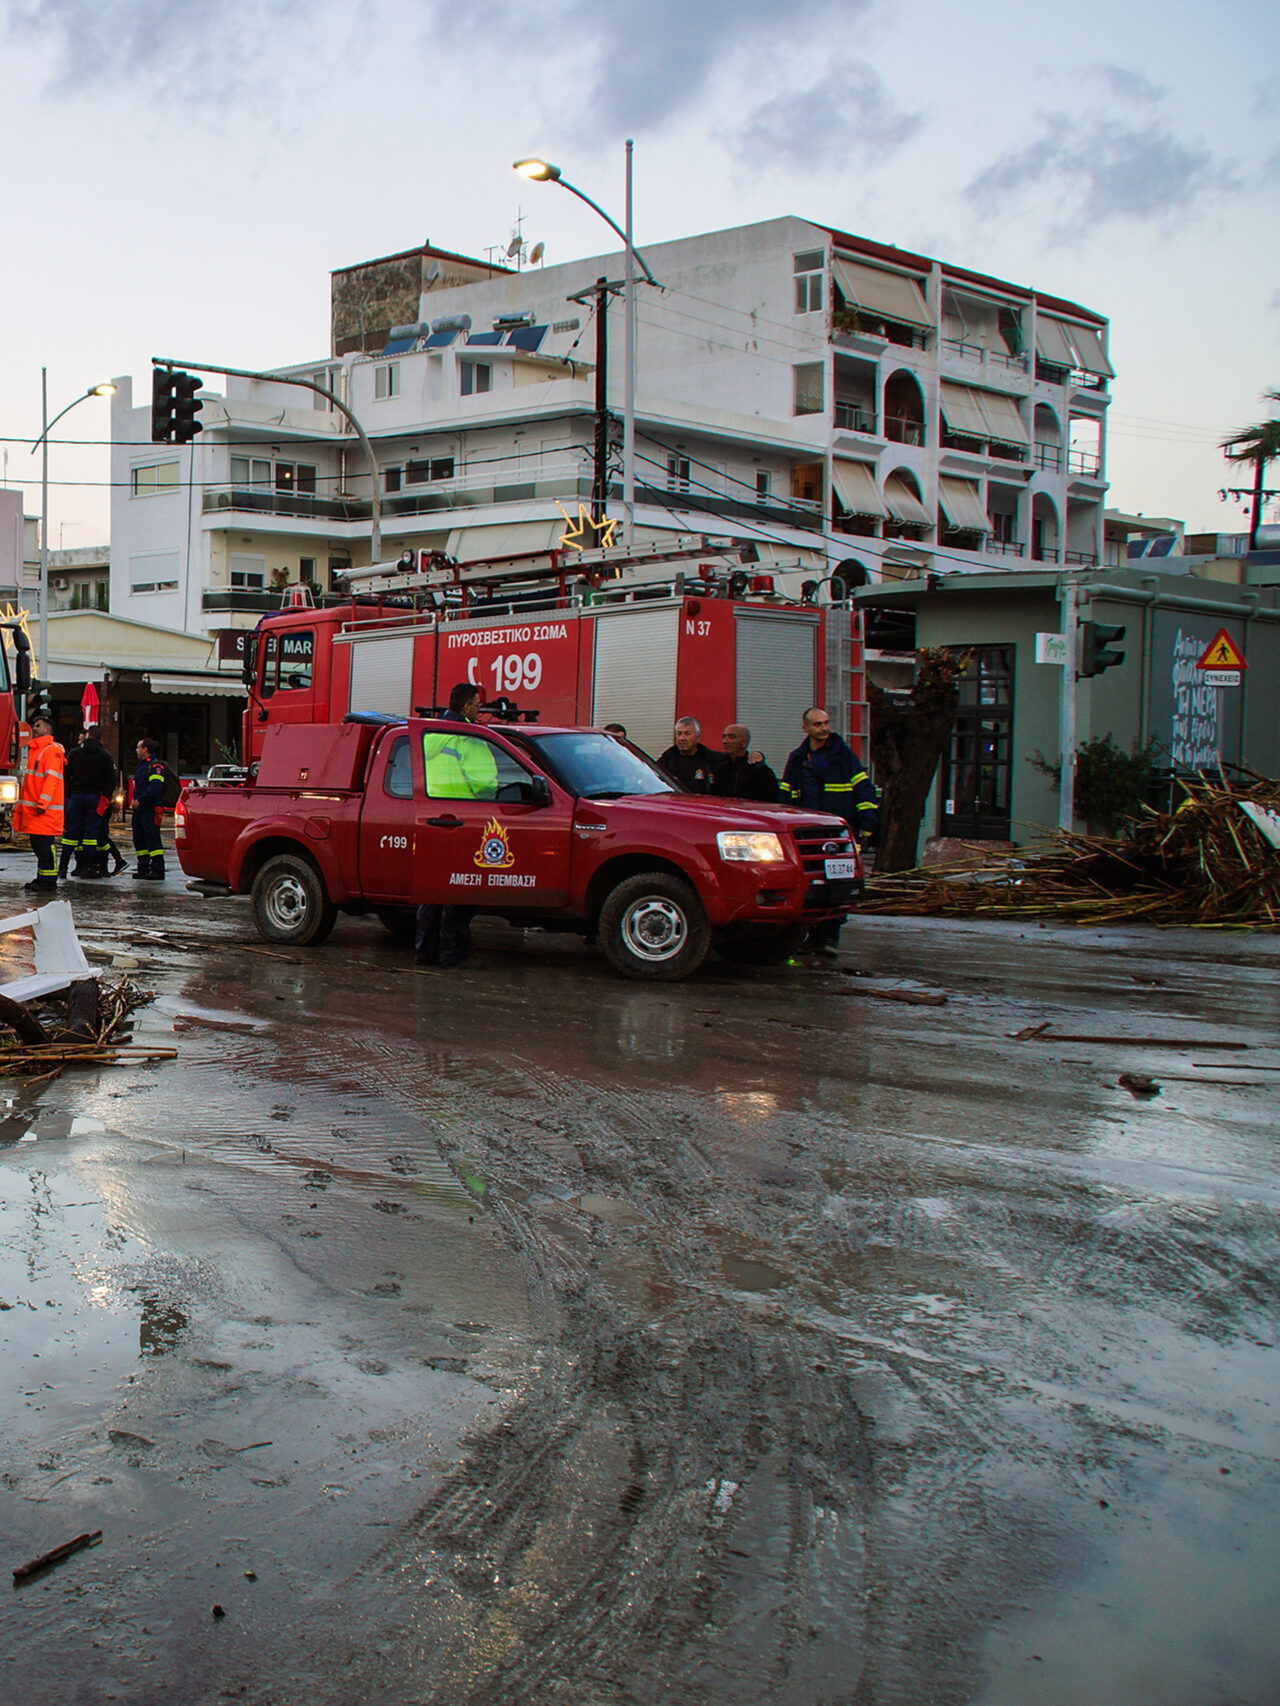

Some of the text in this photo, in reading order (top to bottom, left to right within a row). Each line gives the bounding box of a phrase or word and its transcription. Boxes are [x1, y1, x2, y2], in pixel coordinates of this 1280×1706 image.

[686, 619, 711, 636] N 37
[448, 624, 567, 649] ΠΥΡΟΣΒΕΣΤΙΚΟ ΣΩΜΑ
[283, 639, 312, 655] MAR
[490, 652, 542, 692] 199
[387, 835, 407, 848] 199
[449, 873, 536, 887] ΑΜΕΣΗ ΕΠΕΜΒΑΣΗ
